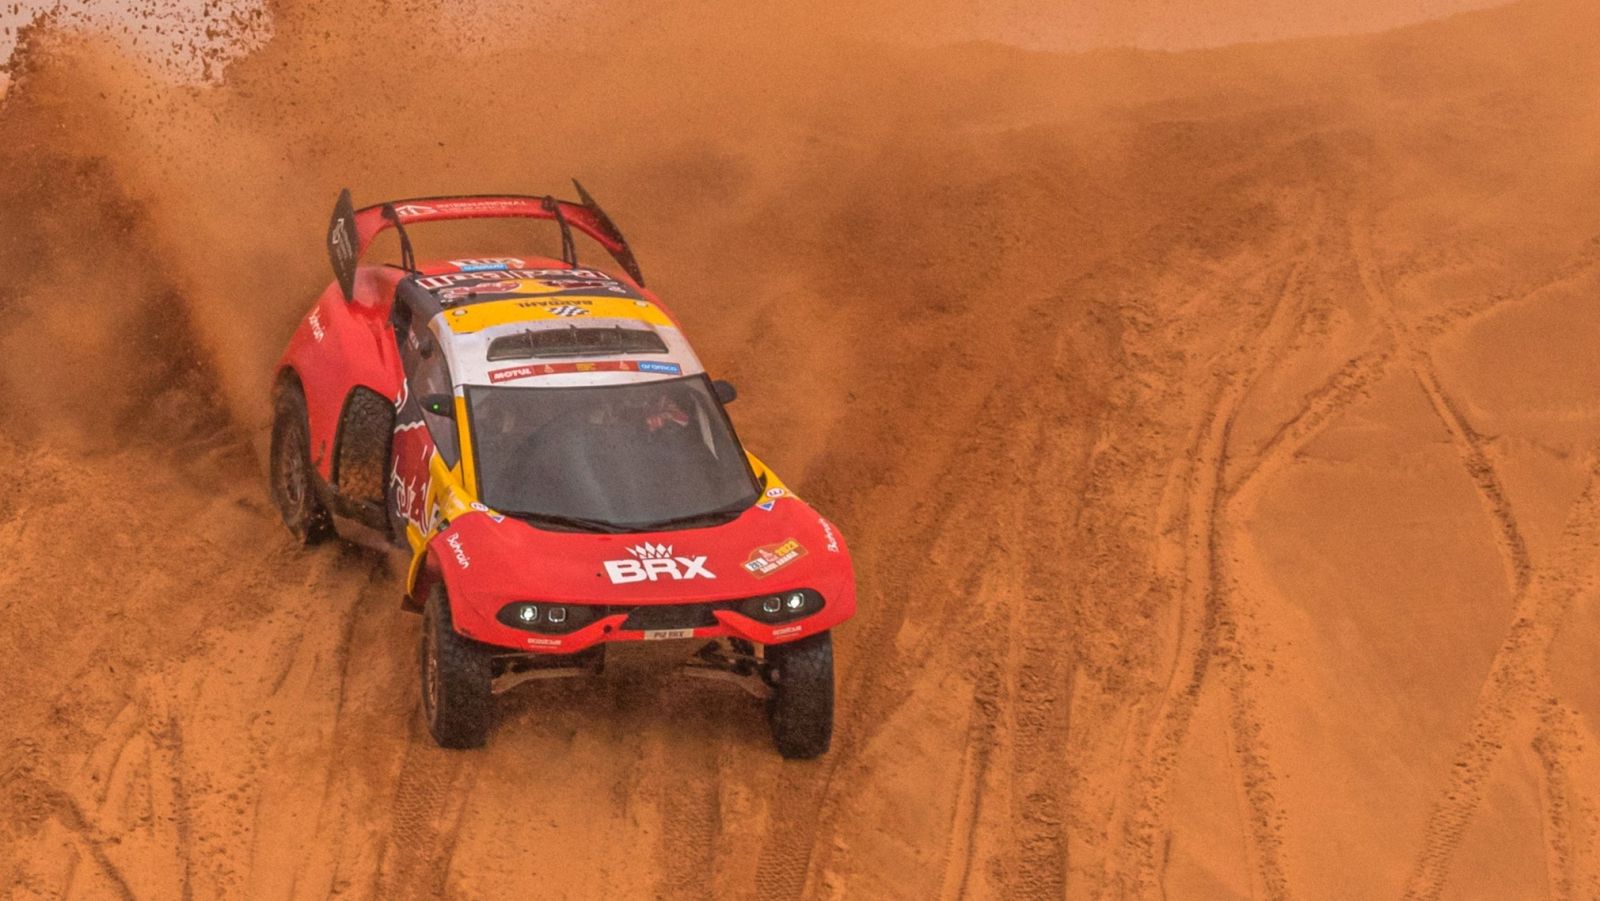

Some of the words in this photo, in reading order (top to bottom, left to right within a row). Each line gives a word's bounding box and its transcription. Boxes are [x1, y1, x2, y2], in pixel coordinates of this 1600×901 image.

[493, 368, 532, 380] MOTUL
[446, 532, 471, 571] Bahrain
[603, 555, 717, 585] BRX
